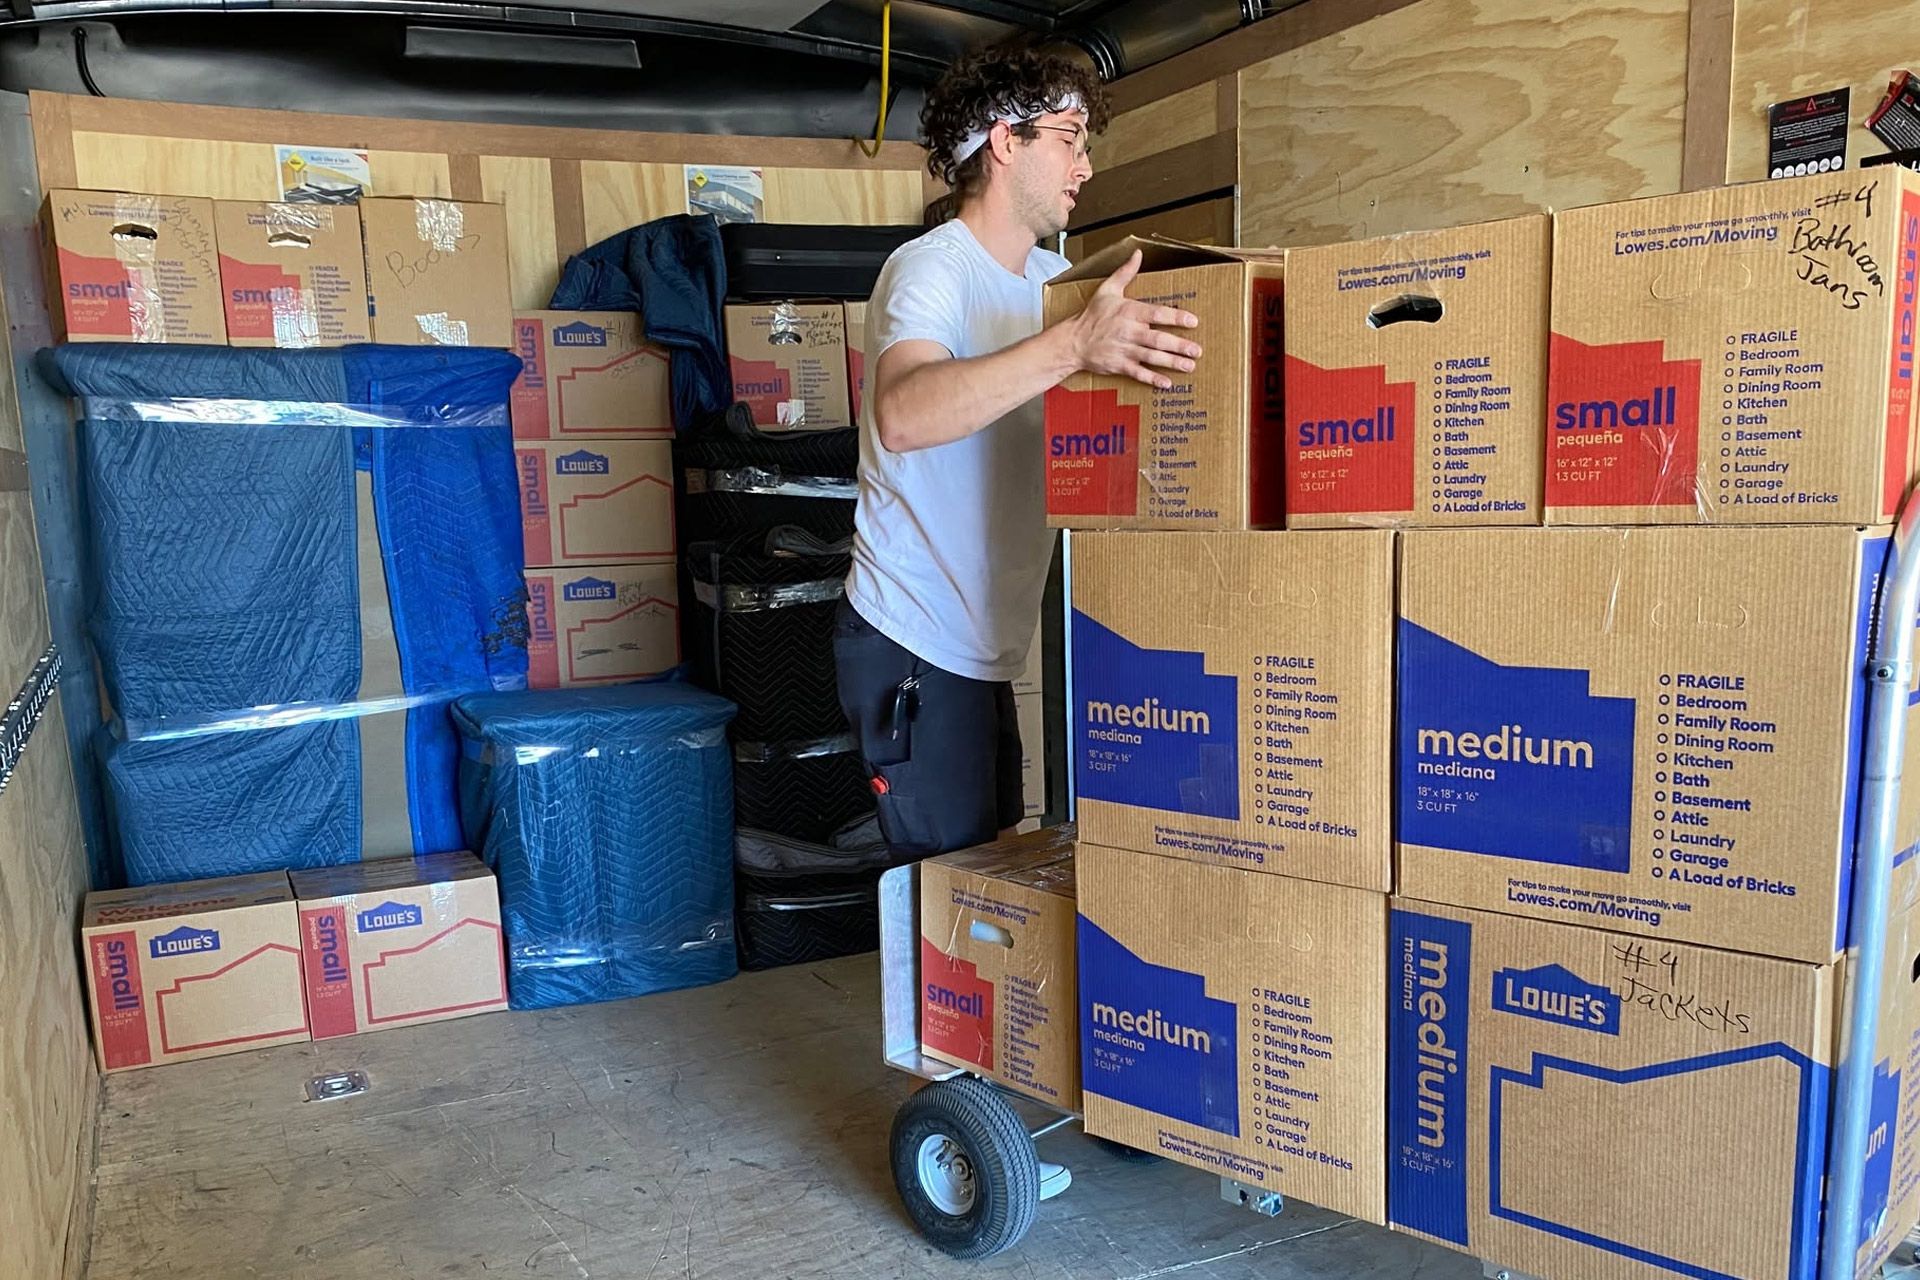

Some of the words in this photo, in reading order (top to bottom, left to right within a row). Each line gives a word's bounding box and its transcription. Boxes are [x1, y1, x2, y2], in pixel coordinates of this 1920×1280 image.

[1615, 225, 1778, 255] Lowes.com/Moving
[1338, 264, 1466, 291] Lowes.com/Moving
[559, 331, 601, 344] LOWE'S
[1741, 330, 1797, 344] FRAGILE
[521, 326, 543, 388] small
[1740, 349, 1799, 361] Bedroom
[1446, 357, 1490, 370] FRAGILE
[1739, 365, 1781, 377] Family
[1785, 362, 1823, 374] Room
[736, 378, 782, 395] small
[1446, 374, 1492, 384] Bedroom
[1738, 381, 1780, 393] Dining
[1783, 380, 1821, 390] Room
[1445, 388, 1479, 399] Family
[1481, 386, 1511, 396] Room
[1445, 403, 1477, 413] Dining
[1480, 401, 1510, 411] Room
[1556, 386, 1676, 430] small
[1737, 397, 1787, 409] Kitchen
[1299, 406, 1394, 446] small
[1445, 417, 1484, 428] Kitchen
[1737, 414, 1767, 425] Bath
[1051, 425, 1125, 456] small
[1445, 431, 1468, 442] Bath
[1557, 430, 1623, 448] pequeña
[1736, 429, 1802, 441] Basement
[1300, 447, 1353, 461] pequeña
[1444, 445, 1496, 456] Basement
[1735, 447, 1767, 456] Attic
[562, 459, 604, 472] LOWE'S
[1052, 457, 1094, 470] pequeña
[1444, 461, 1469, 470] Attic
[1579, 458, 1592, 467] 12"
[1603, 457, 1617, 466] 12"
[1735, 461, 1789, 473] Laundry
[1444, 474, 1486, 484] Laundry
[1570, 472, 1586, 481] CU
[1589, 471, 1601, 480] FT
[1734, 478, 1783, 490] Garage
[524, 455, 546, 516] small
[1444, 489, 1482, 499] Garage
[1734, 494, 1743, 504] A
[1747, 493, 1779, 504] Load
[1781, 493, 1795, 503] of
[1798, 492, 1838, 503] Bricks
[569, 585, 611, 598] LOWE'S
[532, 583, 554, 641] small
[1266, 656, 1314, 669] FRAGILE
[1266, 673, 1316, 685] Bedroom
[1677, 674, 1744, 690] FRAGILE
[1266, 689, 1302, 703] Family
[1305, 691, 1337, 704] Room
[1676, 694, 1747, 711] Bedroom
[1088, 698, 1210, 734] medium
[1266, 705, 1301, 719] Dining
[1305, 707, 1336, 720] Room
[1266, 721, 1309, 734] Kitchen
[1675, 713, 1726, 731] Family
[1730, 718, 1776, 733] Room
[1089, 729, 1142, 744] mediana
[1266, 737, 1292, 749] Bath
[1675, 734, 1724, 752] Dining
[1728, 737, 1774, 752] Room
[1418, 724, 1593, 768] medium
[1267, 753, 1323, 768] Basement
[1674, 753, 1733, 770] Kitchen
[1267, 768, 1294, 781] Attic
[1418, 762, 1495, 780] mediana
[1673, 773, 1710, 787] Bath
[1267, 784, 1313, 800] Laundry
[1268, 800, 1309, 815] Garage
[1417, 801, 1424, 810] 3
[1426, 802, 1441, 812] CU
[1445, 804, 1456, 813] FT
[1672, 791, 1751, 811] Basement
[1268, 815, 1275, 825] A
[1279, 815, 1306, 830] Load
[1309, 821, 1320, 832] of
[1323, 823, 1357, 837] Bricks
[1671, 811, 1709, 827] Attic
[1155, 834, 1264, 863] Lowes.com/Moving
[1671, 830, 1736, 851] Laundry
[1670, 849, 1729, 869] Garage
[1669, 869, 1680, 880] A
[1684, 870, 1723, 887] Load
[1727, 876, 1743, 889] of
[1747, 878, 1796, 897] Bricks
[1508, 878, 1521, 886] For
[1522, 880, 1537, 890] tips
[1539, 882, 1546, 891] to
[1548, 884, 1570, 894] make
[1572, 889, 1590, 897] your
[1592, 891, 1614, 901] move
[1616, 895, 1627, 903] go
[1672, 902, 1691, 912] visit
[99, 897, 236, 917] Welcome
[1508, 888, 1661, 926] Lowes.com/Moving
[364, 911, 415, 929] LOWE'S
[158, 934, 213, 954] LOWE'S
[318, 915, 347, 982] small
[108, 940, 140, 1010] small
[1403, 937, 1417, 1011] mediana
[927, 983, 983, 1019] small
[1264, 989, 1310, 1008] FRAGILE
[1505, 978, 1606, 1025] LOWE'S
[1264, 1005, 1312, 1024] Bedroom
[1093, 1002, 1210, 1054] medium
[1264, 1020, 1299, 1038] Family
[1301, 1028, 1333, 1044] Room
[1094, 1029, 1145, 1051] mediana
[1264, 1035, 1298, 1054] Dining
[1301, 1044, 1332, 1060] Room
[1418, 940, 1458, 1149] medium
[1264, 1050, 1305, 1069] Kitchen
[1265, 1065, 1289, 1080] Bath
[1265, 1080, 1319, 1102] Basement
[1265, 1095, 1291, 1110] Attic
[1266, 1109, 1310, 1131] Laundry
[1266, 1123, 1307, 1143] Garage
[1160, 1137, 1264, 1180] Lowes.com/Moving
